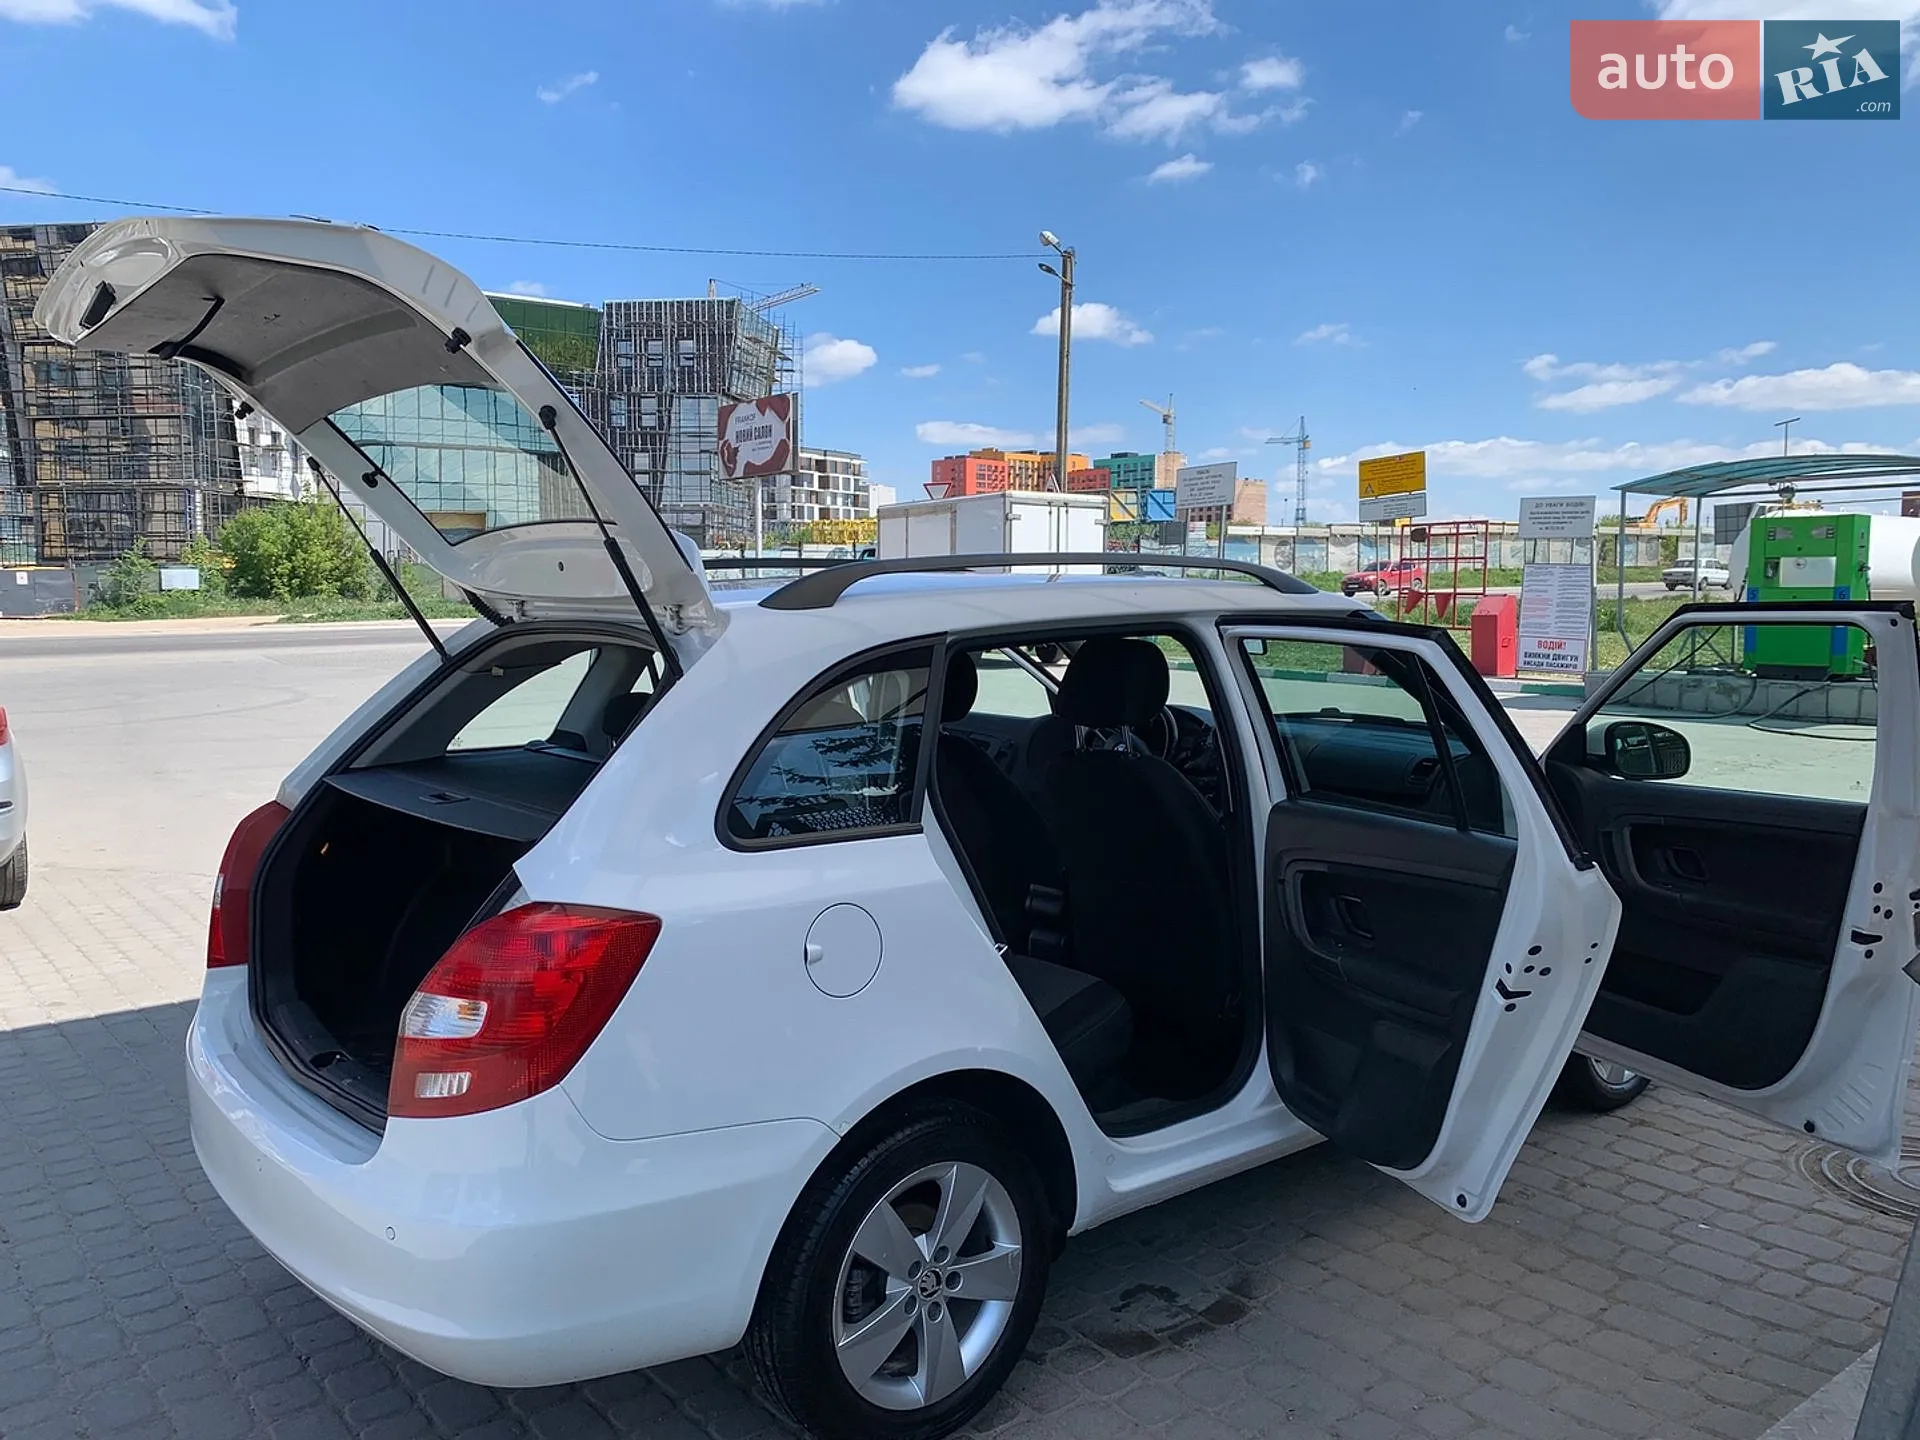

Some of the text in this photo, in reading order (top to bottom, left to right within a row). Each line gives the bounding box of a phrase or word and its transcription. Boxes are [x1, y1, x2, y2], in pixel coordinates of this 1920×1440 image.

[735, 424, 772, 443] НОВИЙ САЛОН
[1537, 640, 1567, 650] ВОДІЙ!
[1552, 653, 1579, 662] ДВИГУН
